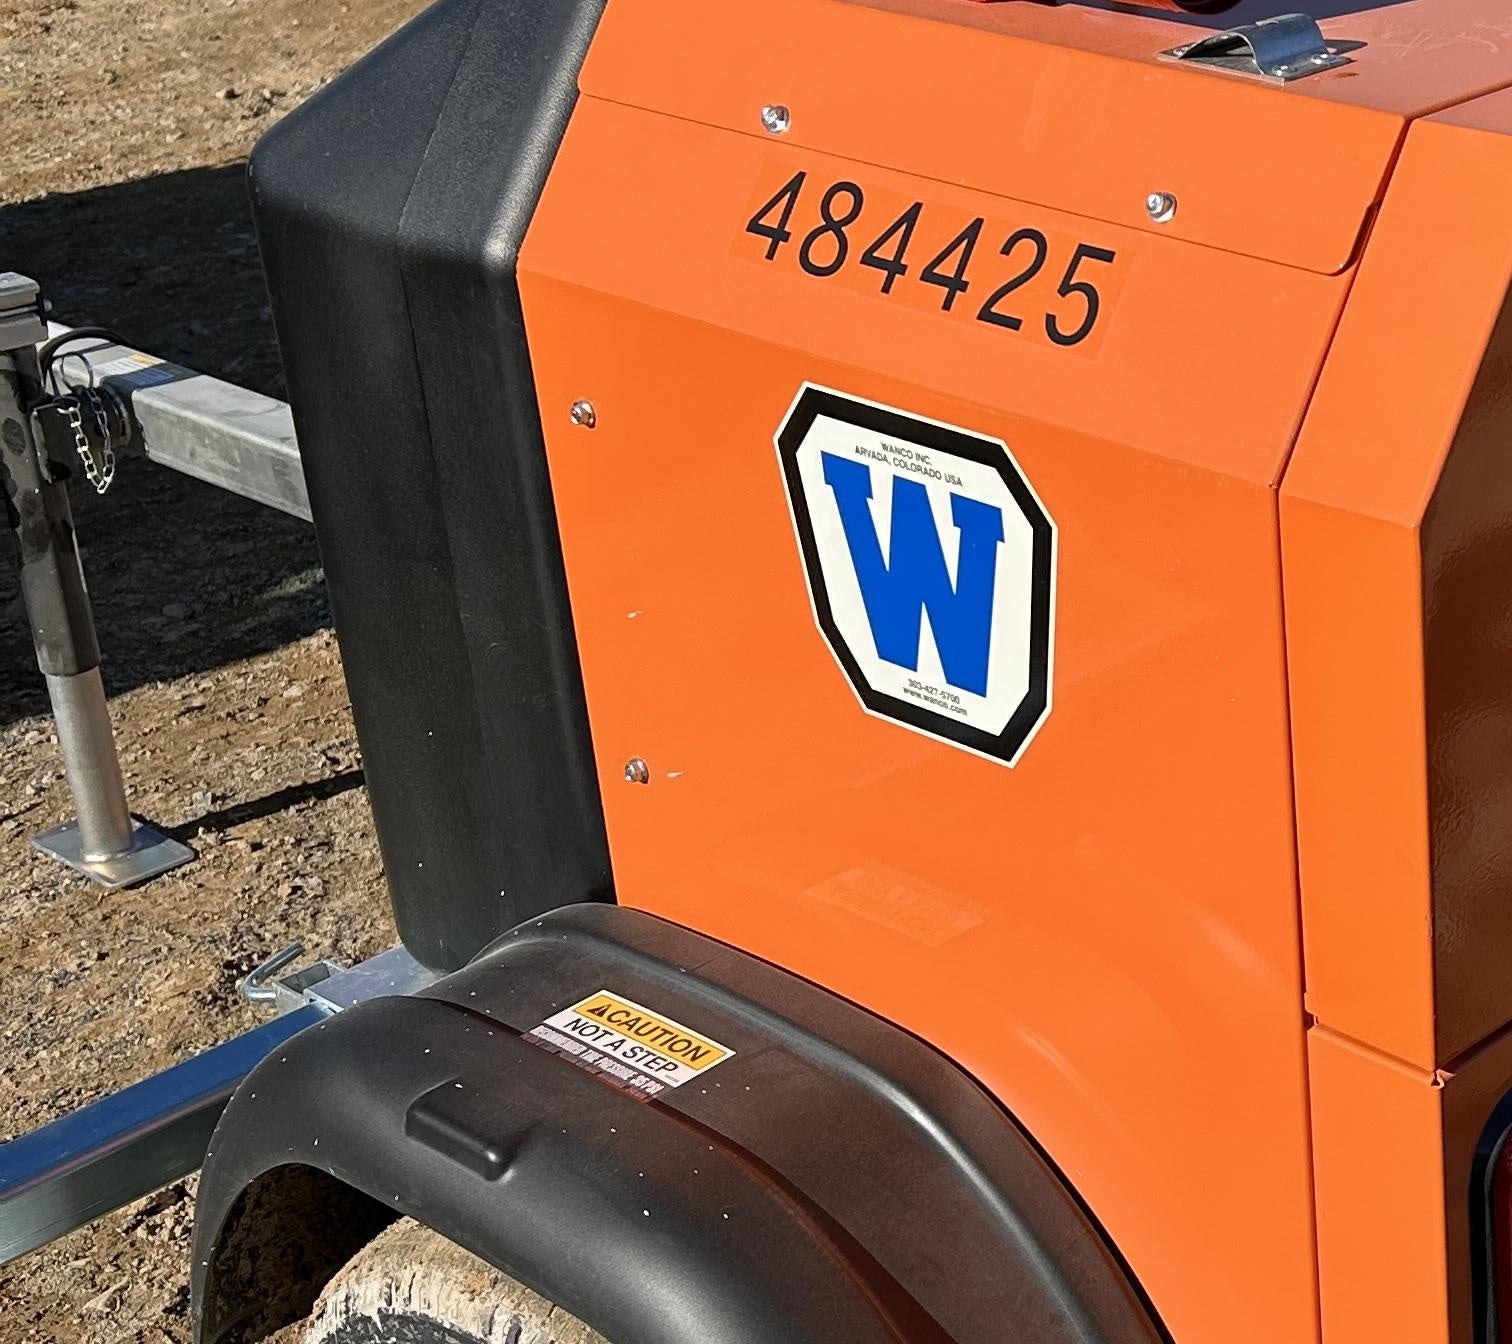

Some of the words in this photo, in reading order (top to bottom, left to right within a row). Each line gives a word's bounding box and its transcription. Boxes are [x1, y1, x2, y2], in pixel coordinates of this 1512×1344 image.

[746, 171, 1116, 347] 484425
[855, 445, 892, 466] ARVADA,
[893, 457, 943, 481] COLORADO
[944, 473, 963, 487] USA
[881, 442, 914, 460] WANCO
[915, 452, 933, 466] INC.
[820, 450, 1005, 698] W
[562, 1018, 614, 1042] NOT
[602, 1037, 626, 1052] A
[621, 1046, 680, 1074] STEP
[607, 1010, 712, 1063] CAUTION
